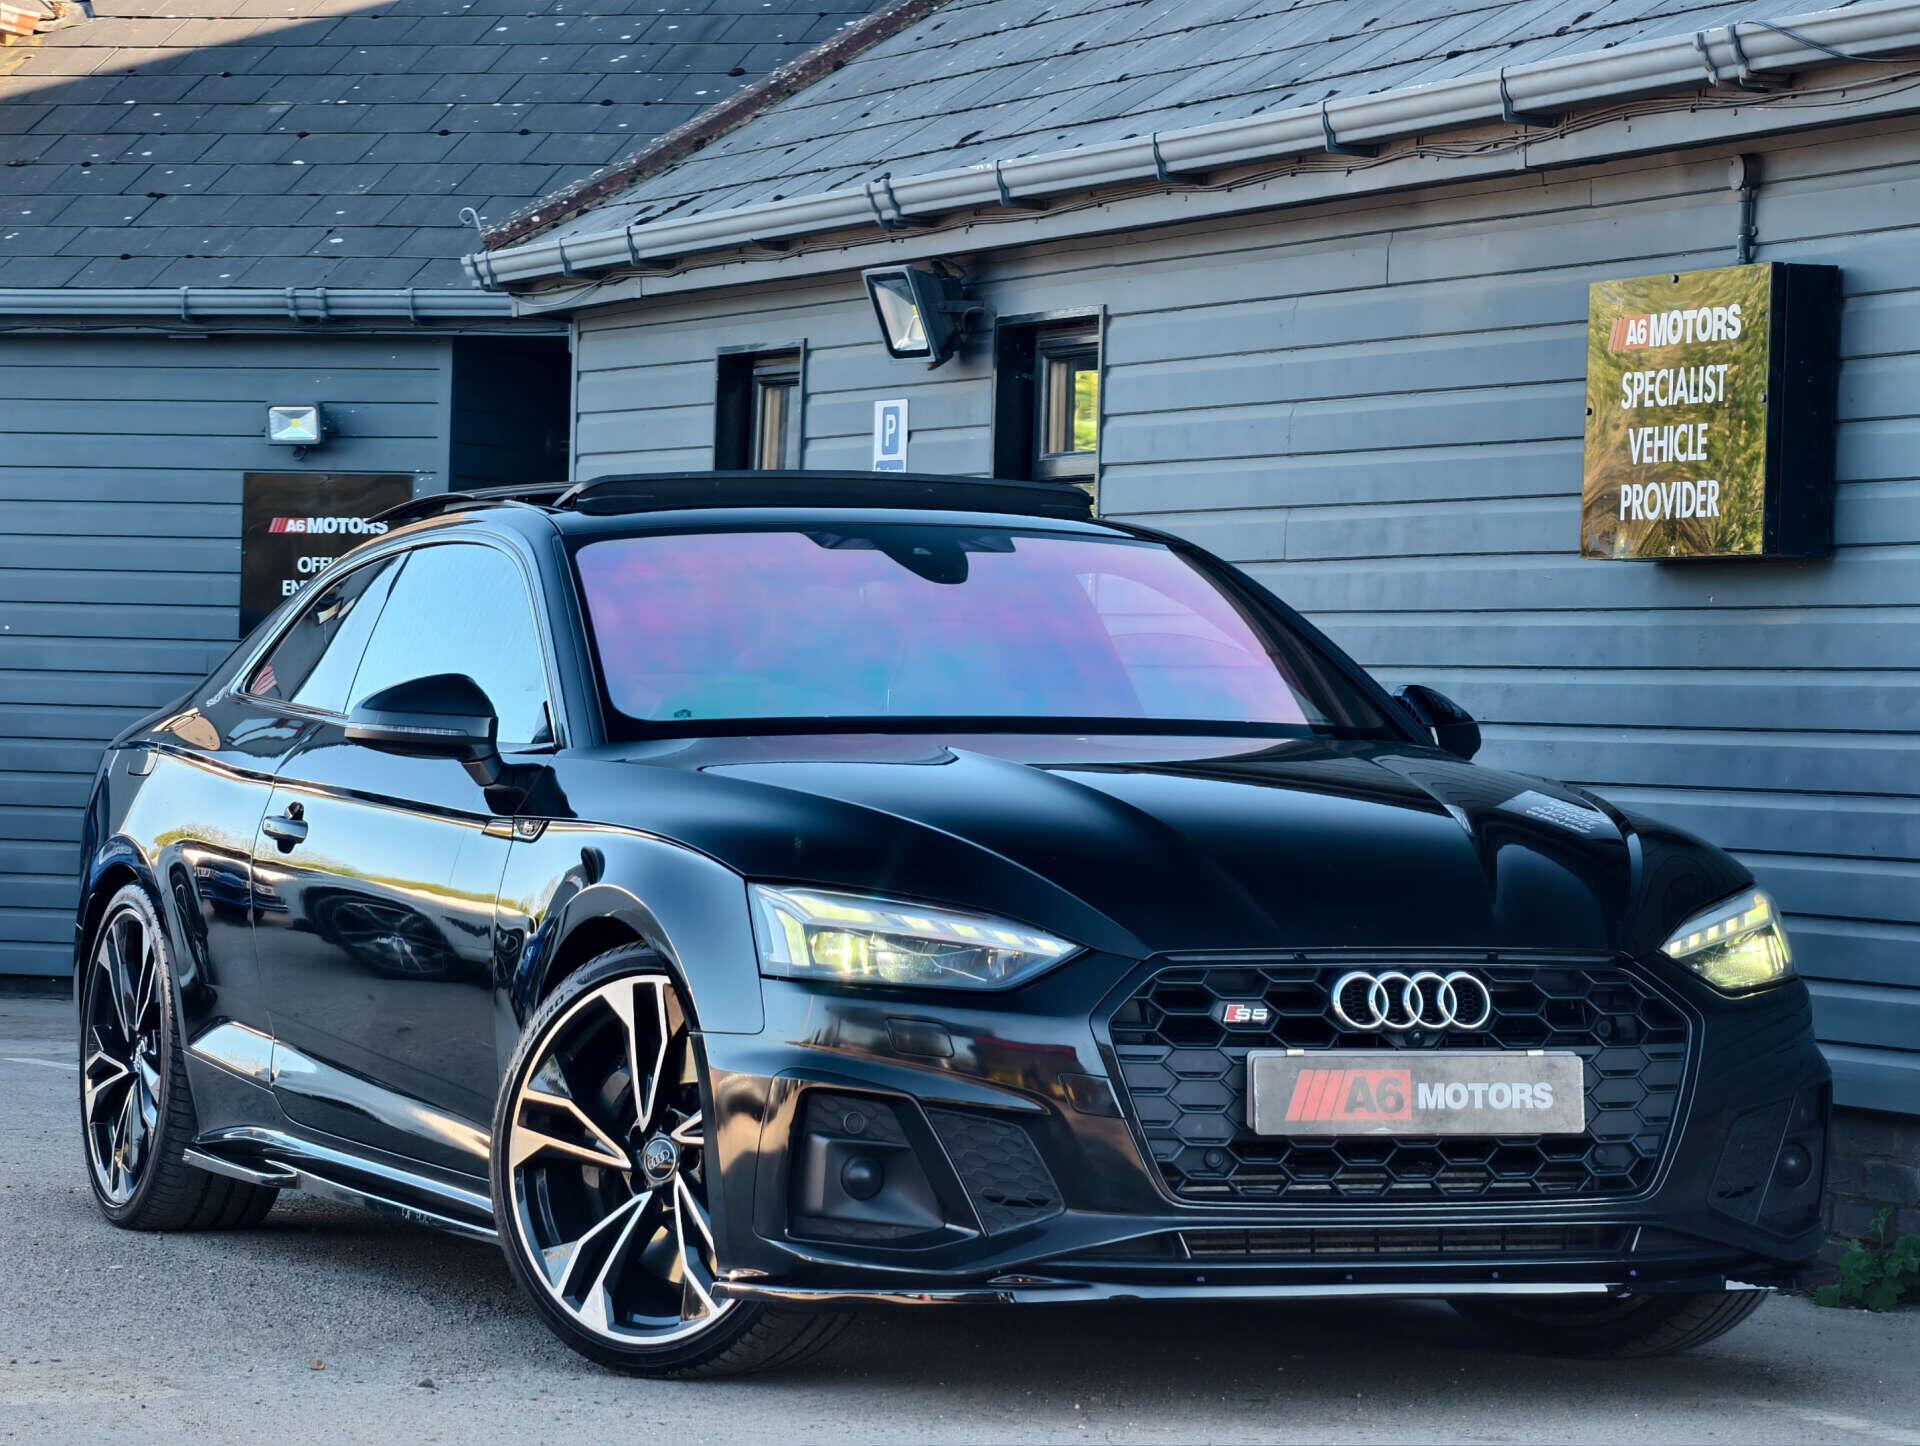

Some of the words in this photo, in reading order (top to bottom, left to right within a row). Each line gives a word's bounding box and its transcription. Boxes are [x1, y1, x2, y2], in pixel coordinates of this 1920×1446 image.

[1649, 303, 1742, 347] MOTORS
[1621, 364, 1728, 409] SPECIALIST
[885, 413, 897, 447] P
[1628, 423, 1708, 465] VEHICLE
[1620, 480, 1720, 521] PROVIDER
[297, 556, 336, 573] OFF
[282, 579, 309, 596] EN
[1234, 1007, 1268, 1020] S5
[1343, 1078, 1405, 1114] A6
[1418, 1082, 1554, 1109] MOTORS
